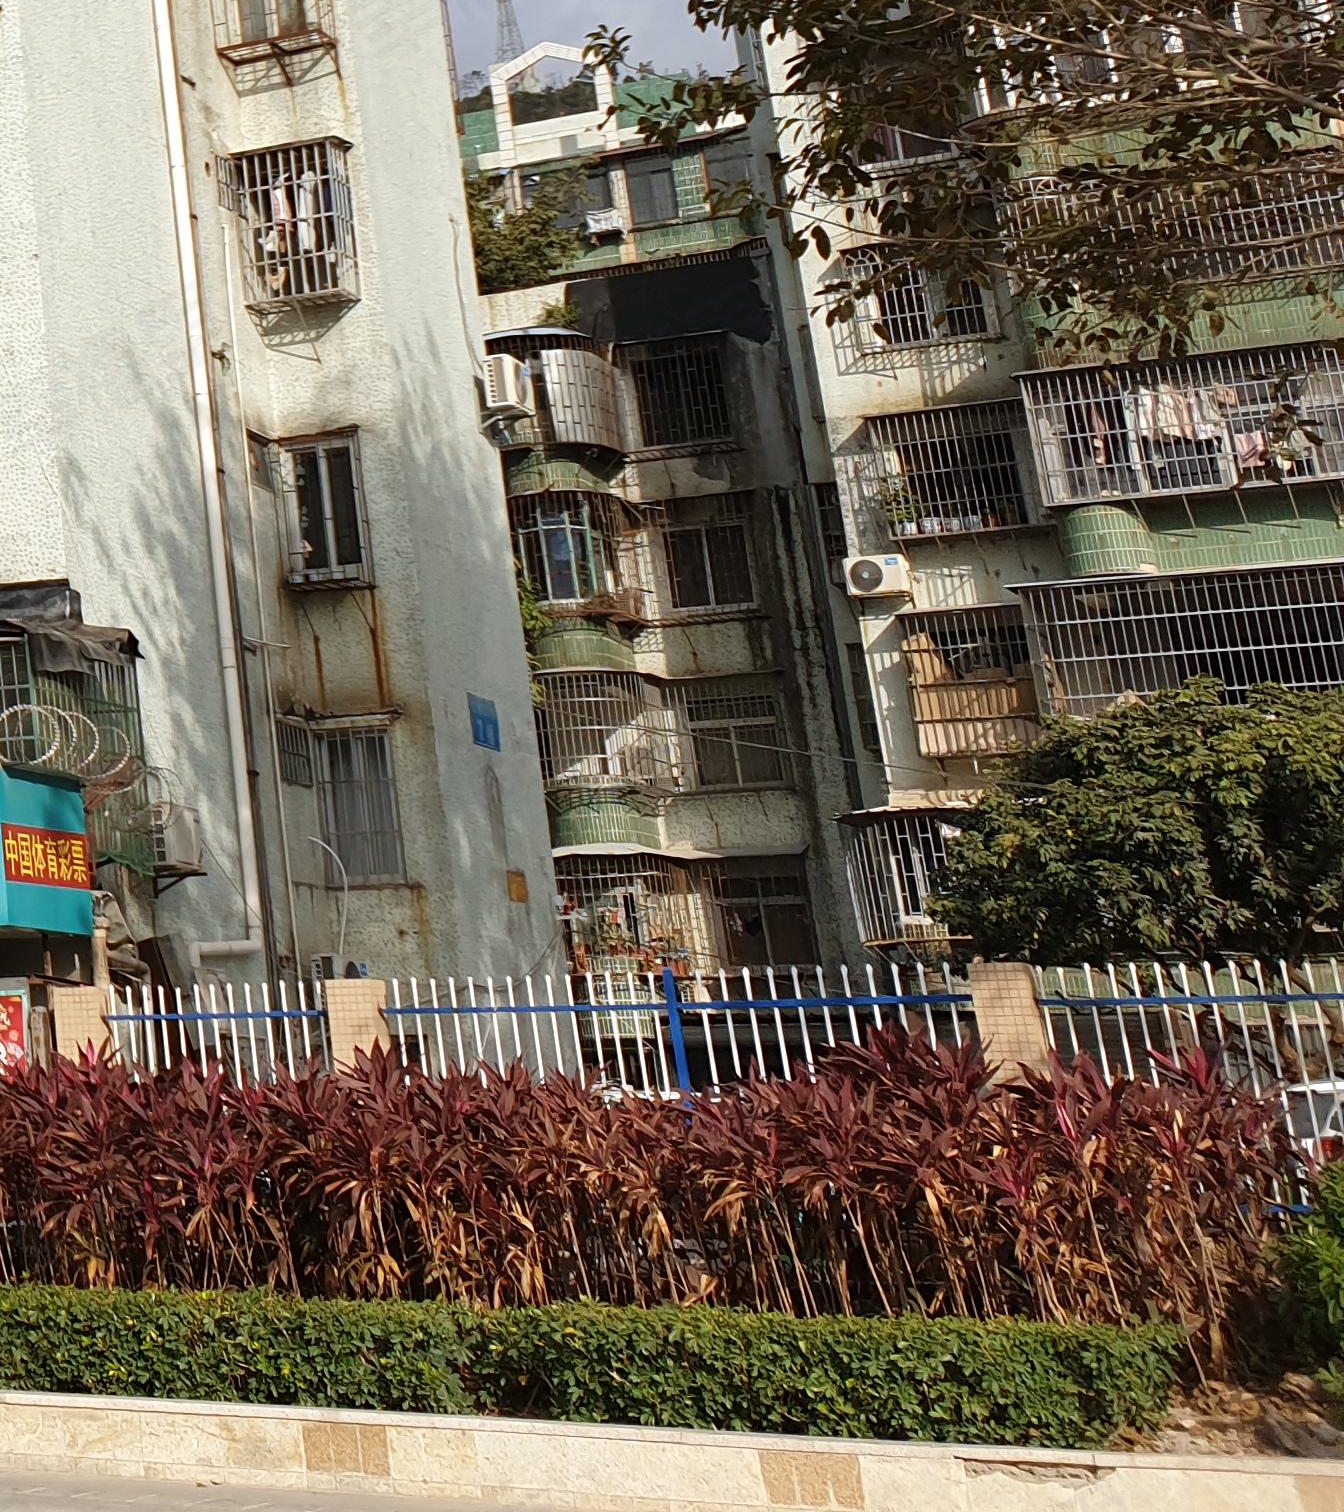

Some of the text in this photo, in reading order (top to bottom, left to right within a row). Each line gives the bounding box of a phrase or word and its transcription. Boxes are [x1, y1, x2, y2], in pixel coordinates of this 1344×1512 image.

[5, 830, 87, 883] 中国体育彩票
